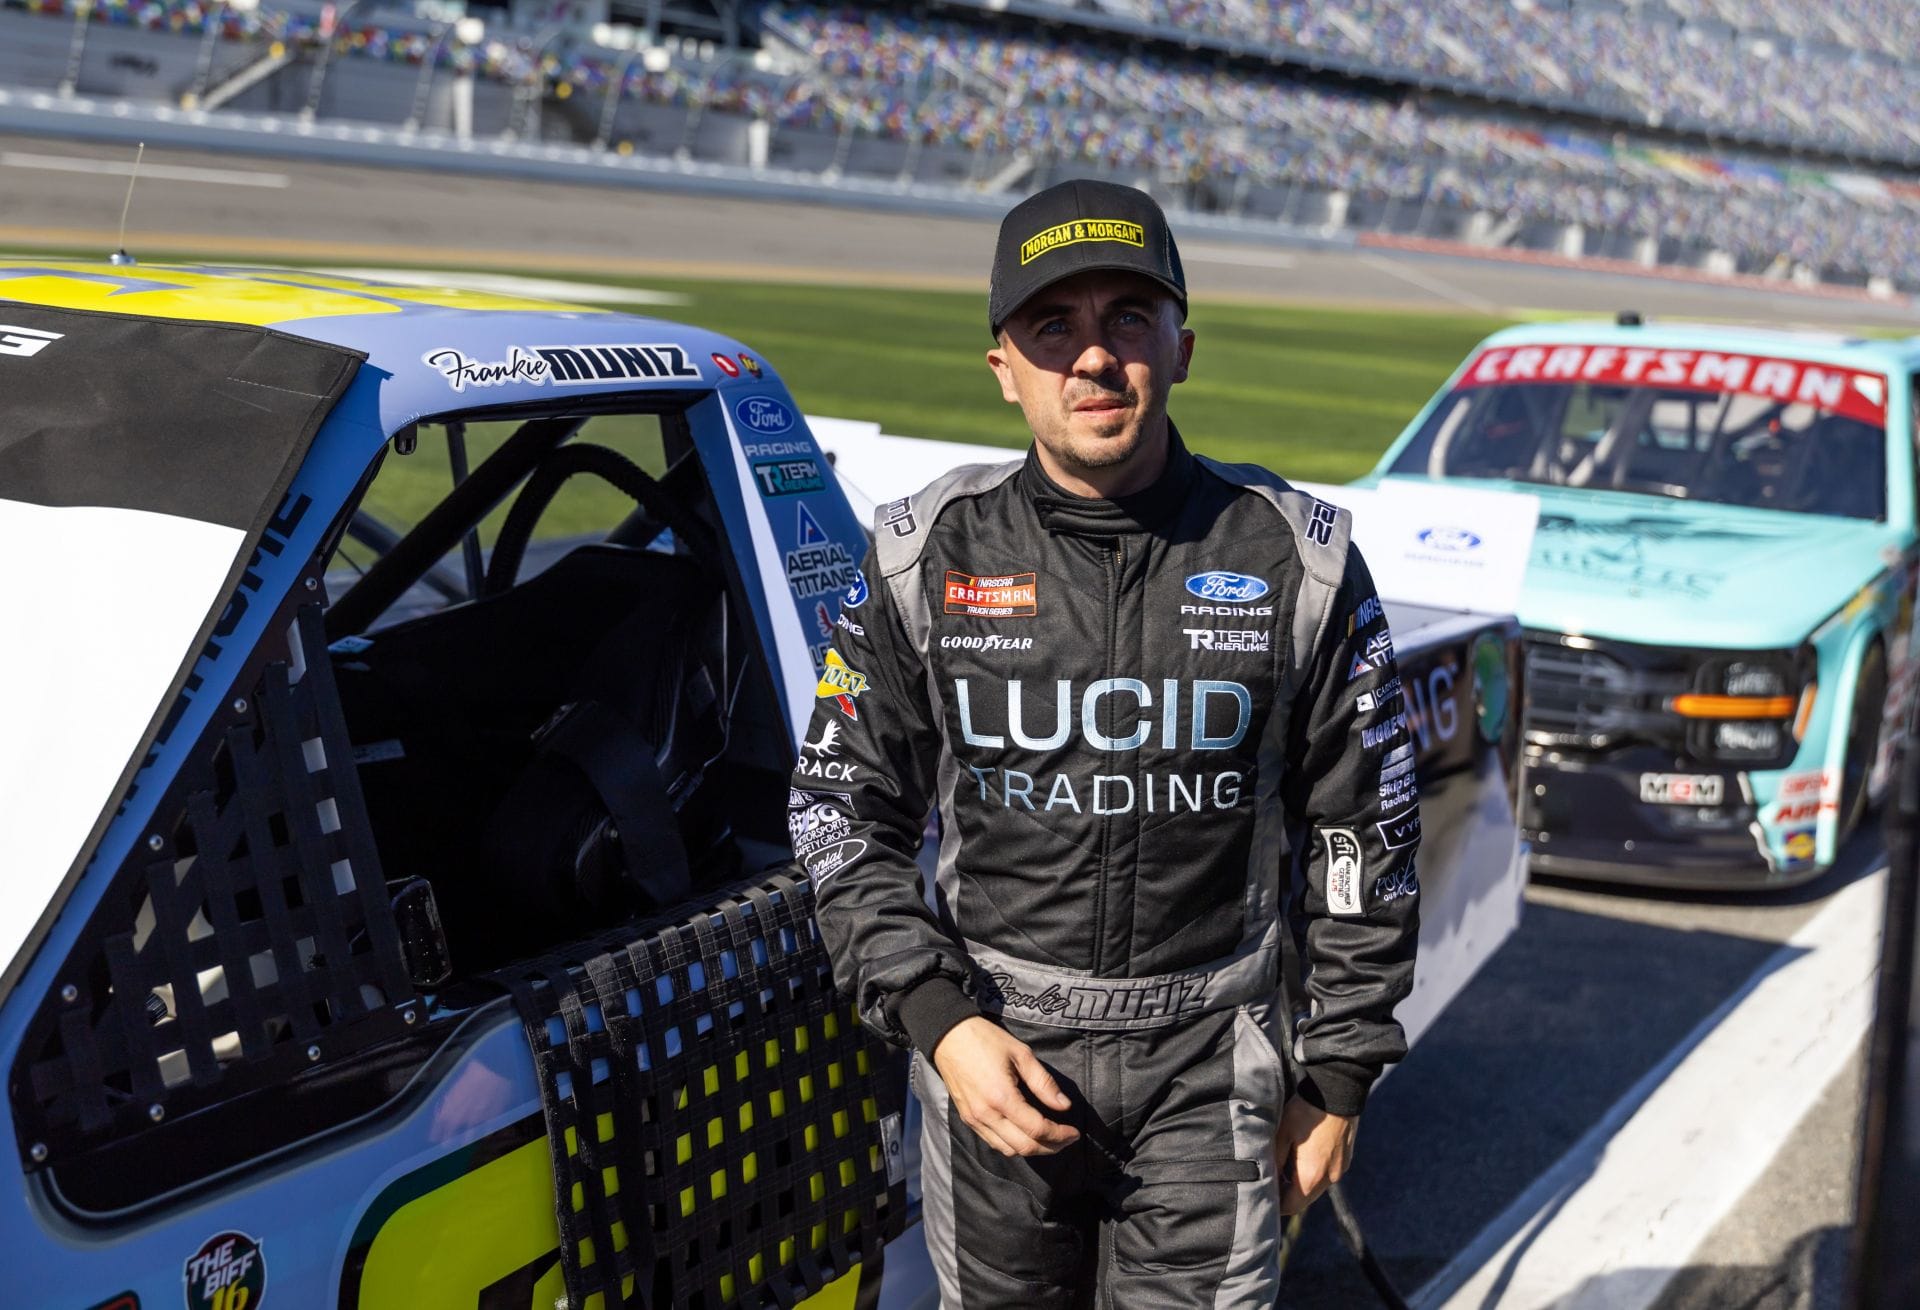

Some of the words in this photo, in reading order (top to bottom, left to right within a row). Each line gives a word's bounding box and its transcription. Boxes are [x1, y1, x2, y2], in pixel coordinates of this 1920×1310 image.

[1026, 225, 1071, 258] MORGAN
[1074, 224, 1085, 238] &
[1087, 222, 1137, 241] MORGAN
[429, 349, 548, 388] Frankie
[536, 346, 698, 381] MUNIZ
[1475, 347, 1845, 405] CRAFTSMAN
[744, 441, 812, 457] RACING
[779, 462, 820, 480] TEAM
[788, 546, 853, 575] AERIAL
[791, 567, 857, 596] TITANS
[949, 586, 1032, 603] CRAFTSMAN
[978, 577, 1014, 588] NASCAR
[967, 605, 989, 615] TRUCK
[989, 607, 1014, 616] SERIES
[1181, 605, 1273, 617] RACING
[941, 634, 1033, 652] GOODYEAR
[1214, 630, 1269, 643] TEAM
[1214, 642, 1269, 652] REAUME
[954, 677, 1252, 751] LUCID
[969, 763, 1243, 816] TRADING
[795, 816, 849, 847] MOTORSPORTS
[795, 839, 820, 859] SAFETY
[820, 826, 851, 846] GROUP
[1344, 861, 1352, 906] MANUFACTURER
[1062, 974, 1209, 1021] MUNIZ
[189, 1238, 236, 1284] THE
[203, 1249, 257, 1300] BIFF
